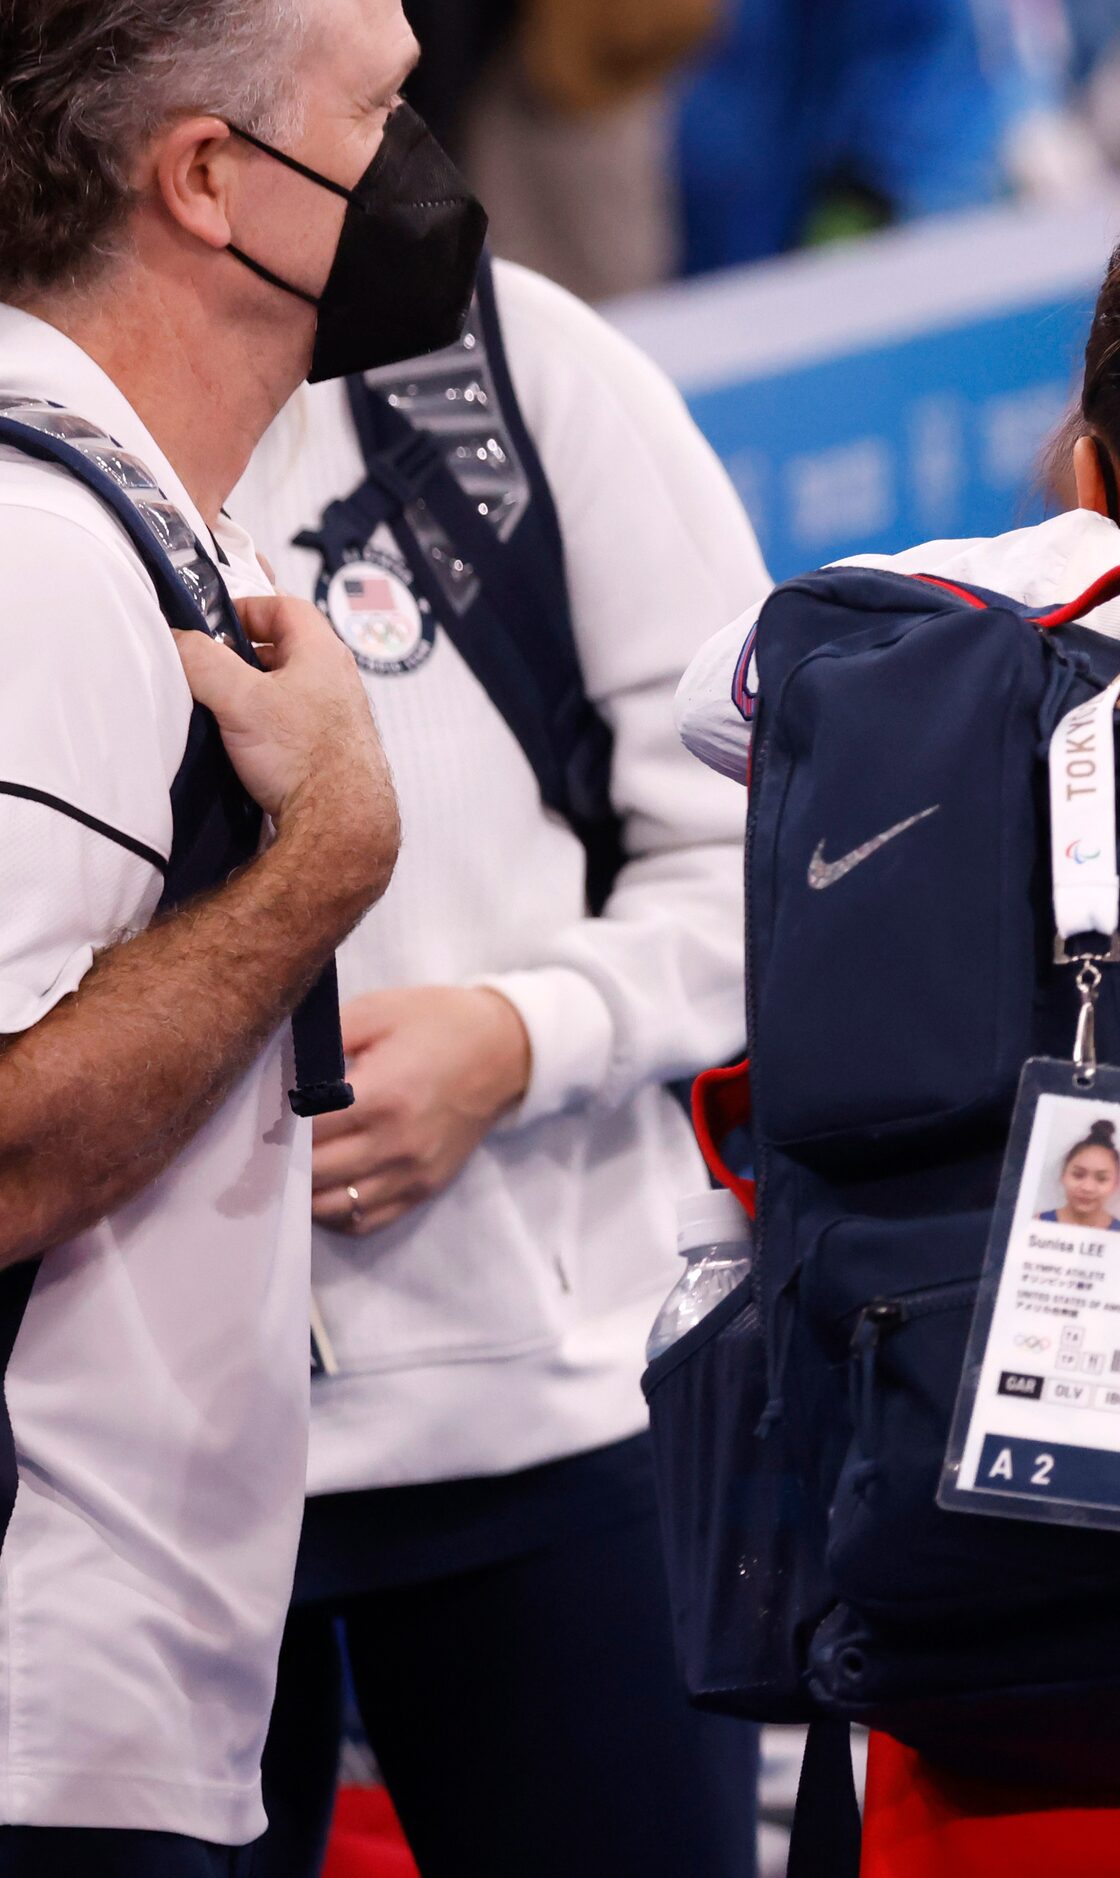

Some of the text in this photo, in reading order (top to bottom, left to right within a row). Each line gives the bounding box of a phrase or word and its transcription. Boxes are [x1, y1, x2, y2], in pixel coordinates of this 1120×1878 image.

[1066, 704, 1098, 801] TOKYO
[1029, 1234, 1105, 1258] Sunisa LEE
[1005, 1375, 1037, 1394] GAR
[988, 1448, 1013, 1480] A
[1030, 1453, 1055, 1485] 2
